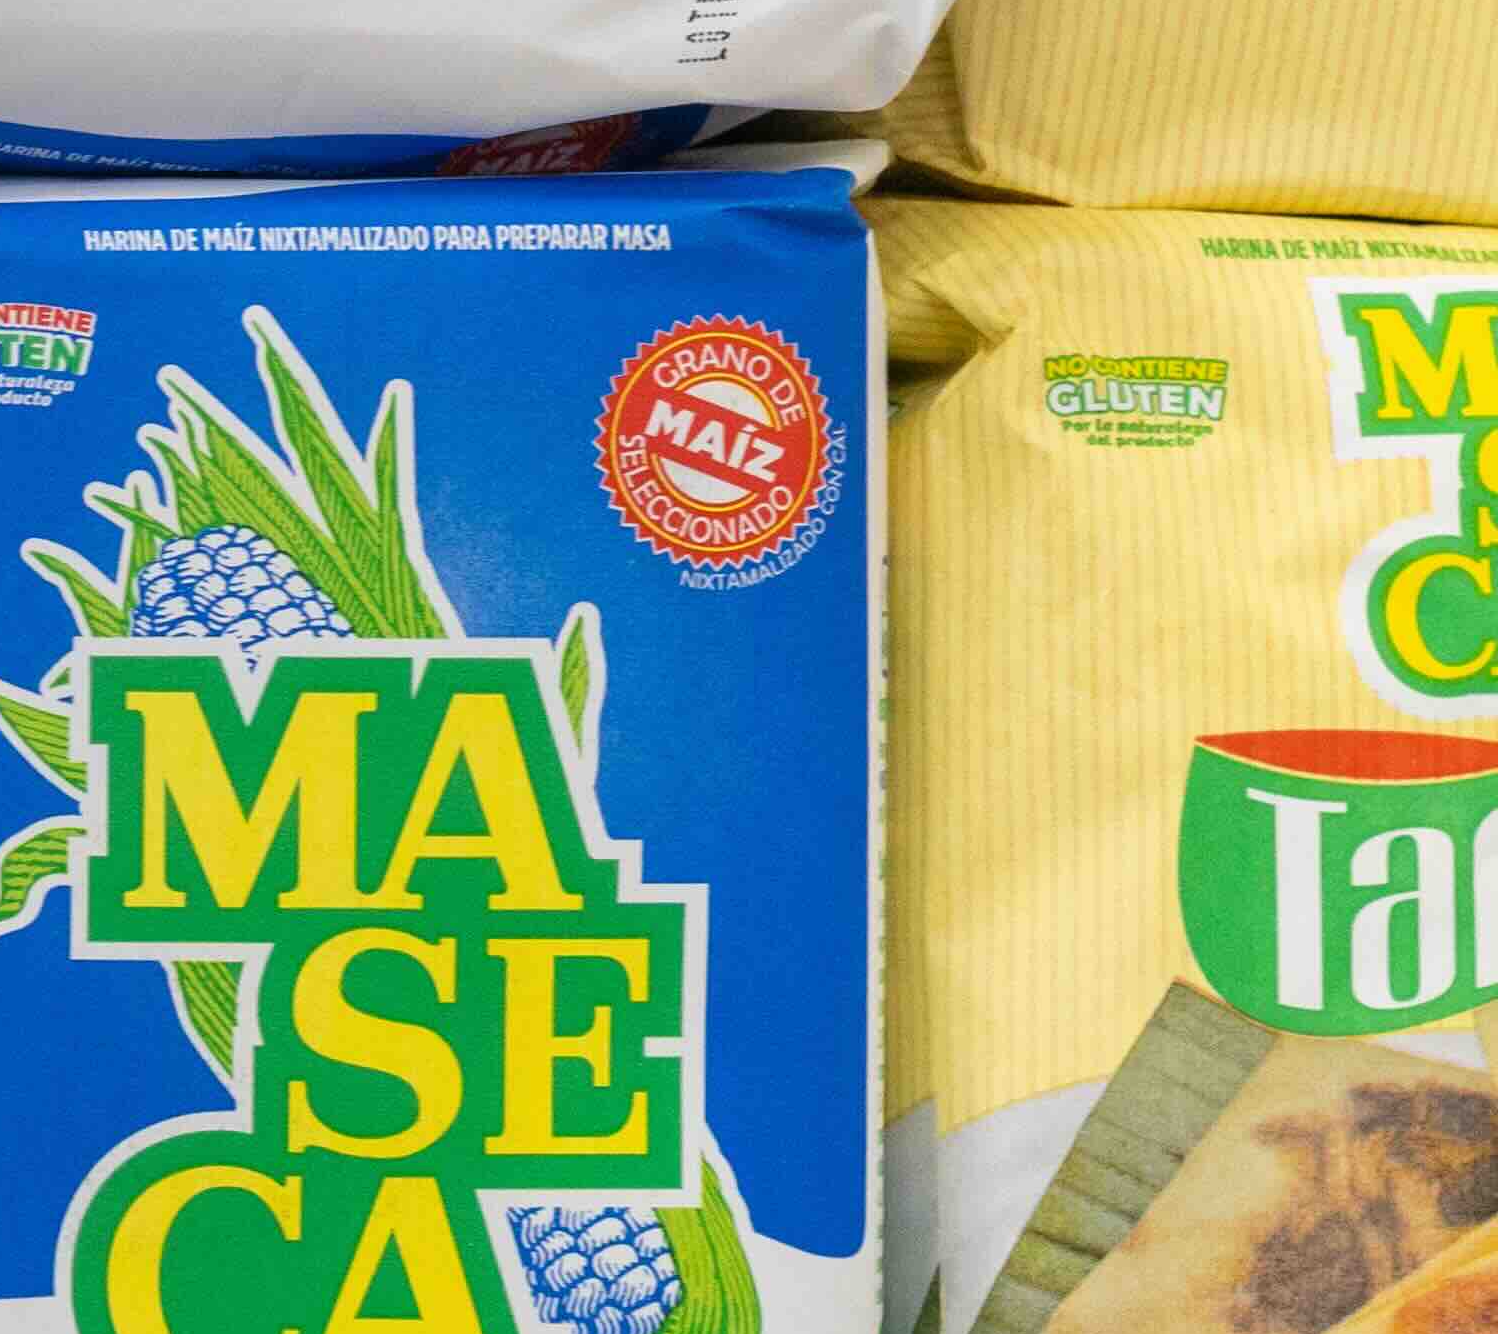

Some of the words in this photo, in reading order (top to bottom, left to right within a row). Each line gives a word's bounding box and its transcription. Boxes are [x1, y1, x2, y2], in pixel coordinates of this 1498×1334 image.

[84, 229, 167, 251] HARINA
[171, 229, 198, 251] DE
[204, 223, 254, 251] MAÍZ
[260, 227, 430, 251] NIXTAMALIZADO
[434, 226, 491, 250] PARA
[496, 225, 608, 250] PREPARAR
[612, 225, 672, 251] MASA
[653, 344, 770, 388] GRANO
[769, 378, 806, 426] DE
[1044, 355, 1089, 380] NO
[1046, 380, 1228, 421] GLUTEN
[645, 398, 785, 483] MAÍZ
[619, 434, 793, 544] SELECCIONADO
[122, 689, 583, 913] MA
[290, 927, 652, 1161] SE
